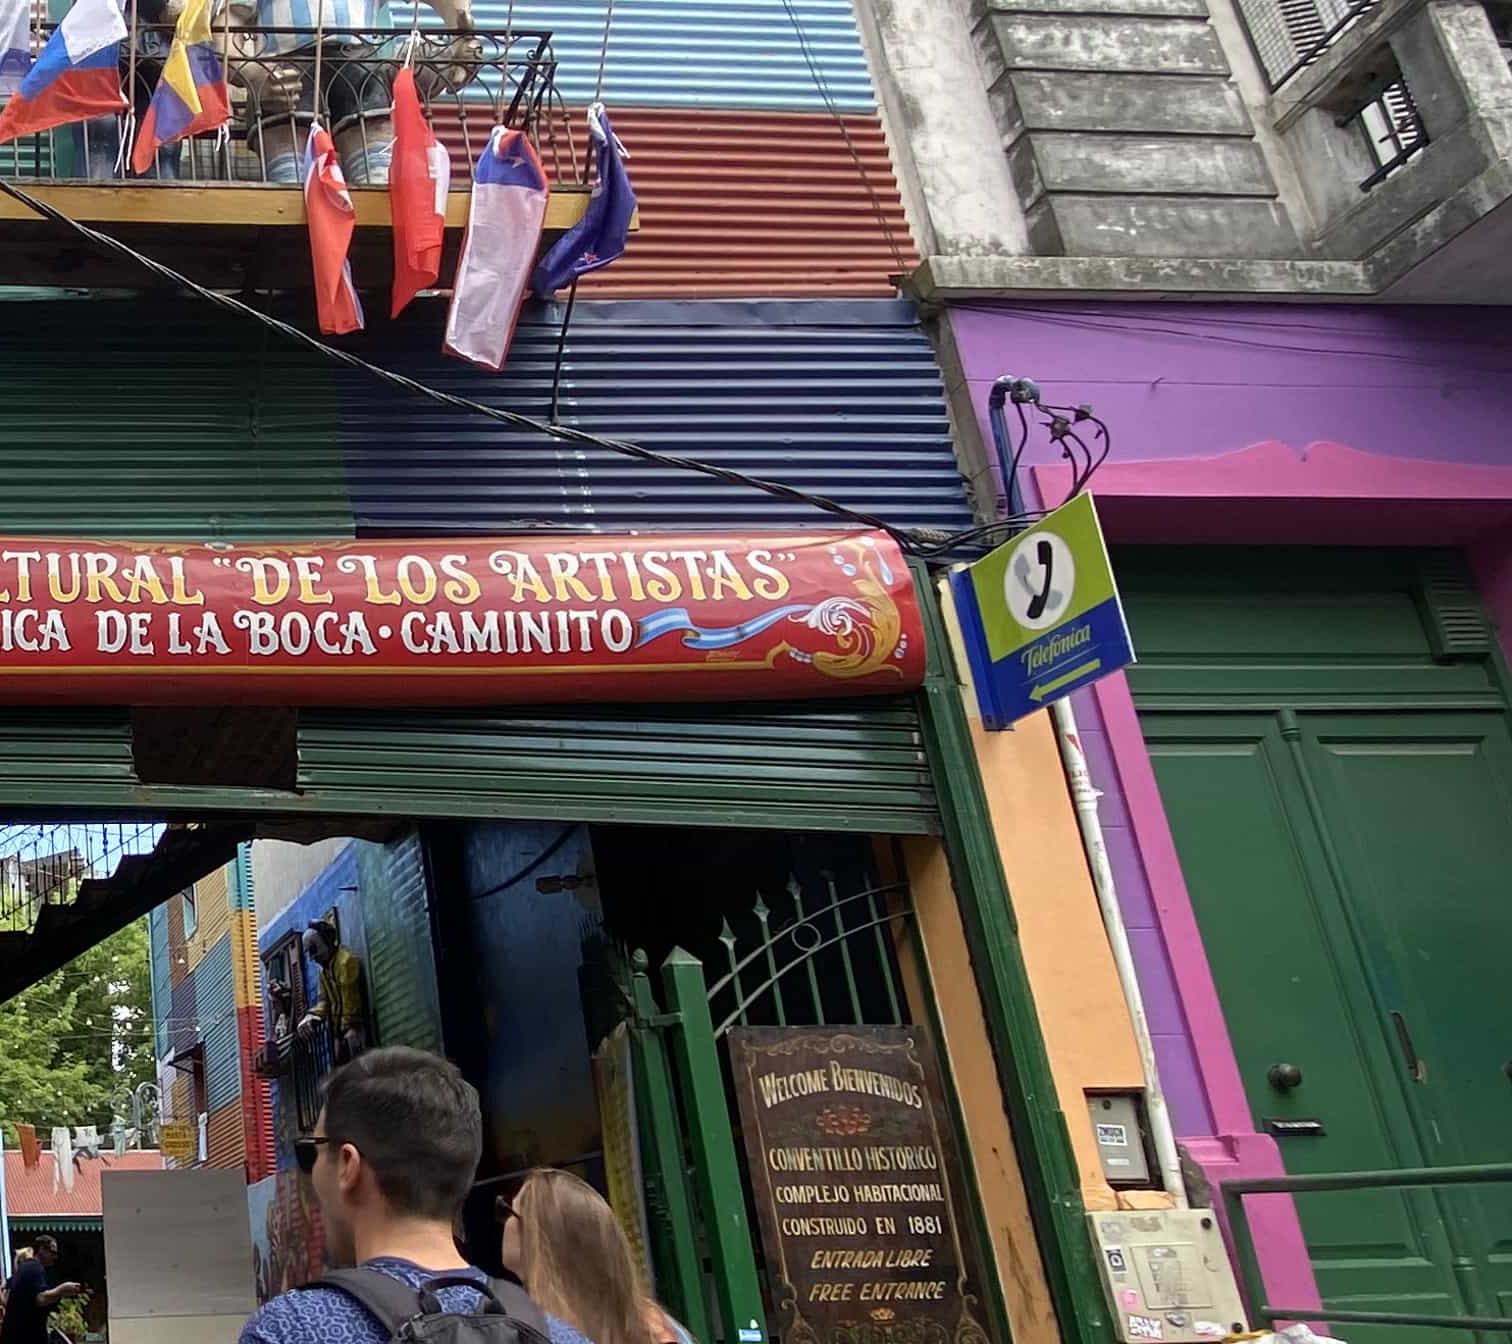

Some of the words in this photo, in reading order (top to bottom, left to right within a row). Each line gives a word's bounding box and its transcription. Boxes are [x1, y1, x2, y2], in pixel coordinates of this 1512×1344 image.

[336, 554, 481, 605] LOS
[95, 609, 155, 655] DE
[168, 611, 232, 655] LA
[401, 608, 633, 655] CAMINITO
[758, 1067, 830, 1109] WELCOME
[830, 1060, 923, 1110] BIENVENIDOS
[769, 1146, 863, 1172] CONVENTILLO
[864, 1145, 937, 1171] HISTORICO
[776, 1184, 850, 1204] COMPLEJO
[853, 1183, 945, 1203] HABITACIONAL
[782, 1216, 868, 1237] CONSTRUIDO
[876, 1216, 896, 1235] EN
[908, 1215, 943, 1235] 1881
[810, 1249, 886, 1269] ENTRADA
[885, 1248, 934, 1267] LIBRE
[808, 1282, 855, 1302] FREE
[859, 1280, 946, 1302] ENTRANCE
